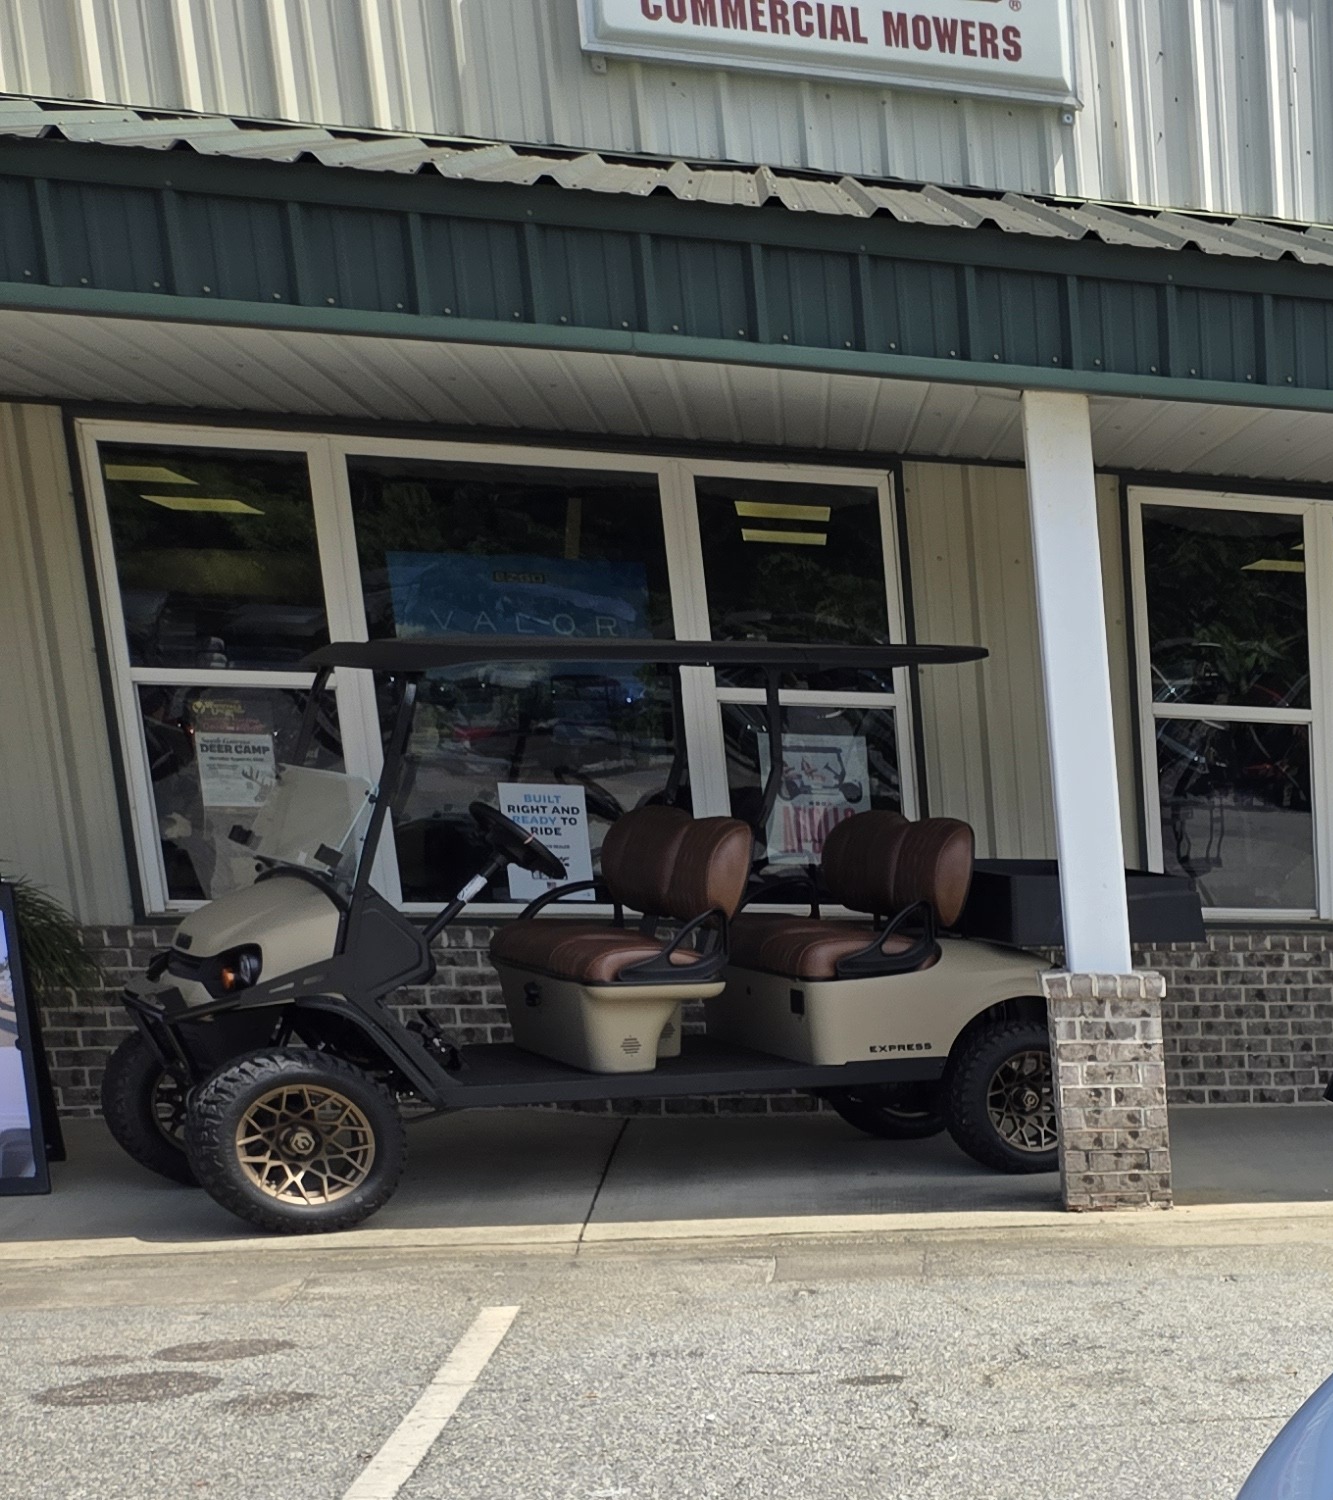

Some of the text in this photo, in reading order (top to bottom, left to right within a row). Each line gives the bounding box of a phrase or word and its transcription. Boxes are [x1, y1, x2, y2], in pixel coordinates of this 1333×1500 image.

[641, 0, 1022, 62] COMMERCIAL MOWERS
[430, 609, 619, 637] VALOR
[200, 743, 270, 755] DEER CAMP
[523, 794, 561, 804] BUILT
[507, 805, 580, 816] RIGHT AND
[511, 815, 578, 826] READY TO
[530, 826, 562, 836] RIDE
[869, 1042, 932, 1053] EXPRESS
